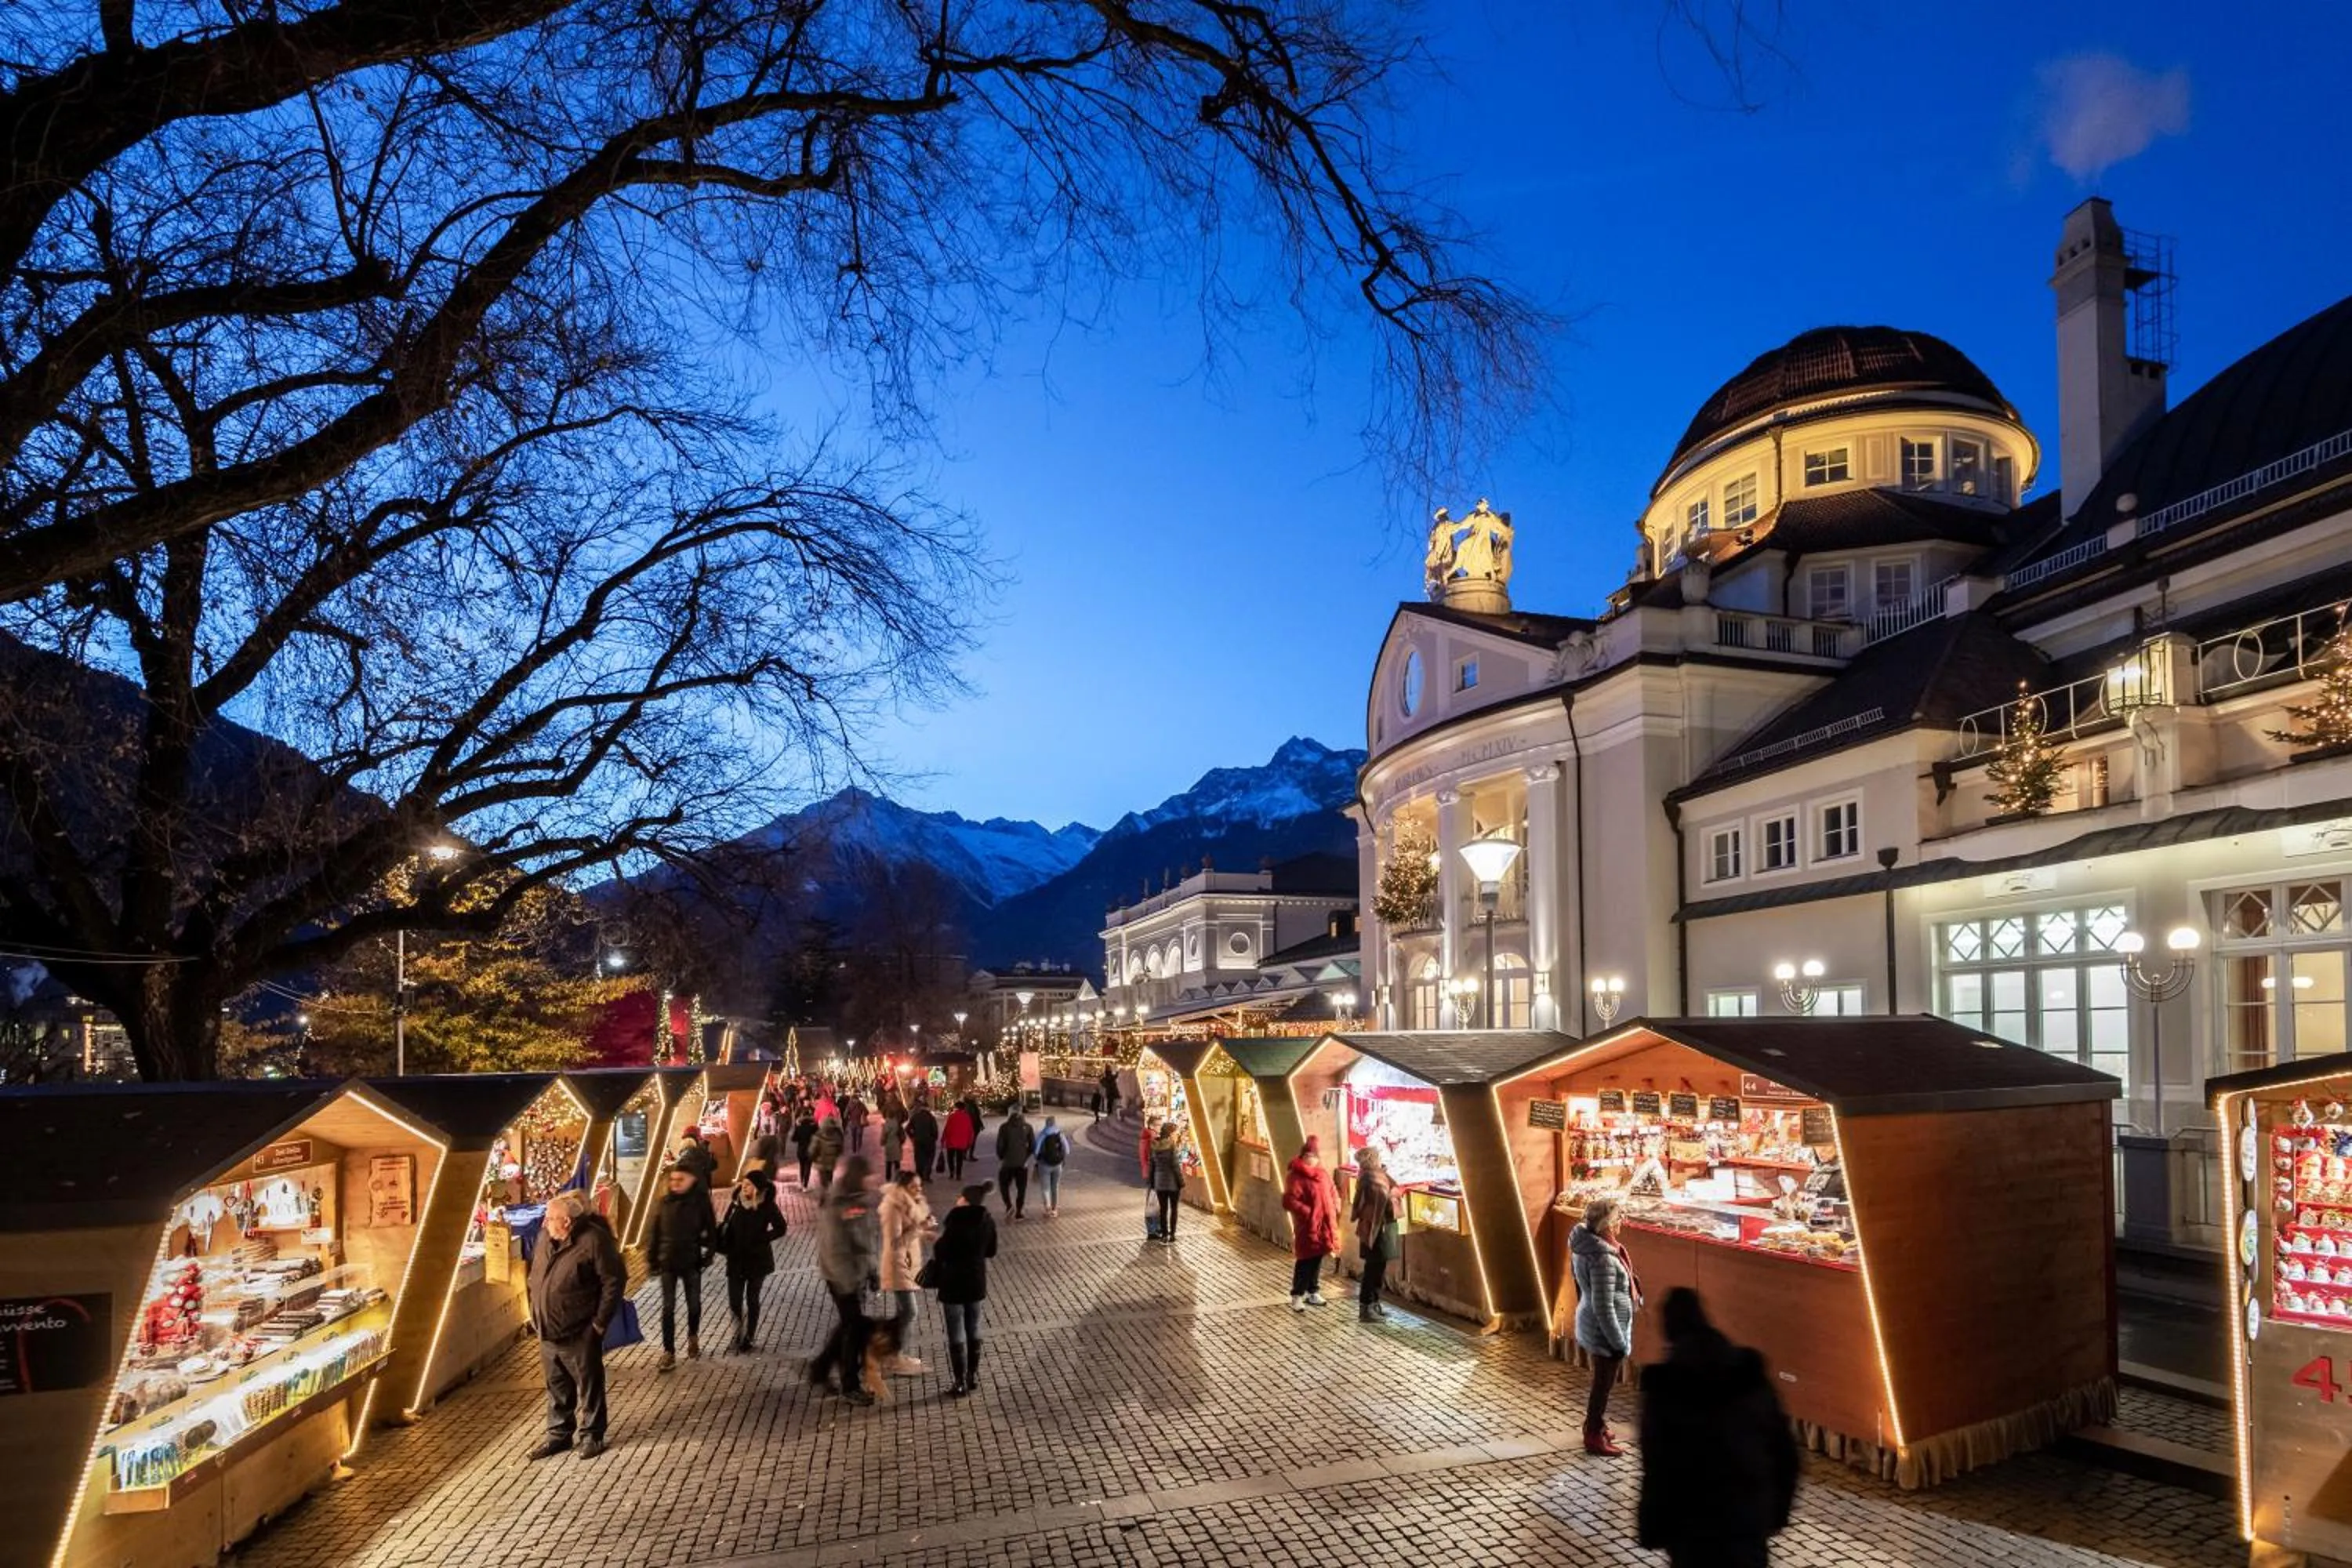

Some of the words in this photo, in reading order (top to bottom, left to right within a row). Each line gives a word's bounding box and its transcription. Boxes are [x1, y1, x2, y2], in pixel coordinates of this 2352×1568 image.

[1744, 1081, 1757, 1091] 44
[0, 1316, 67, 1332] vvento
[2291, 1355, 2352, 1408] 4
